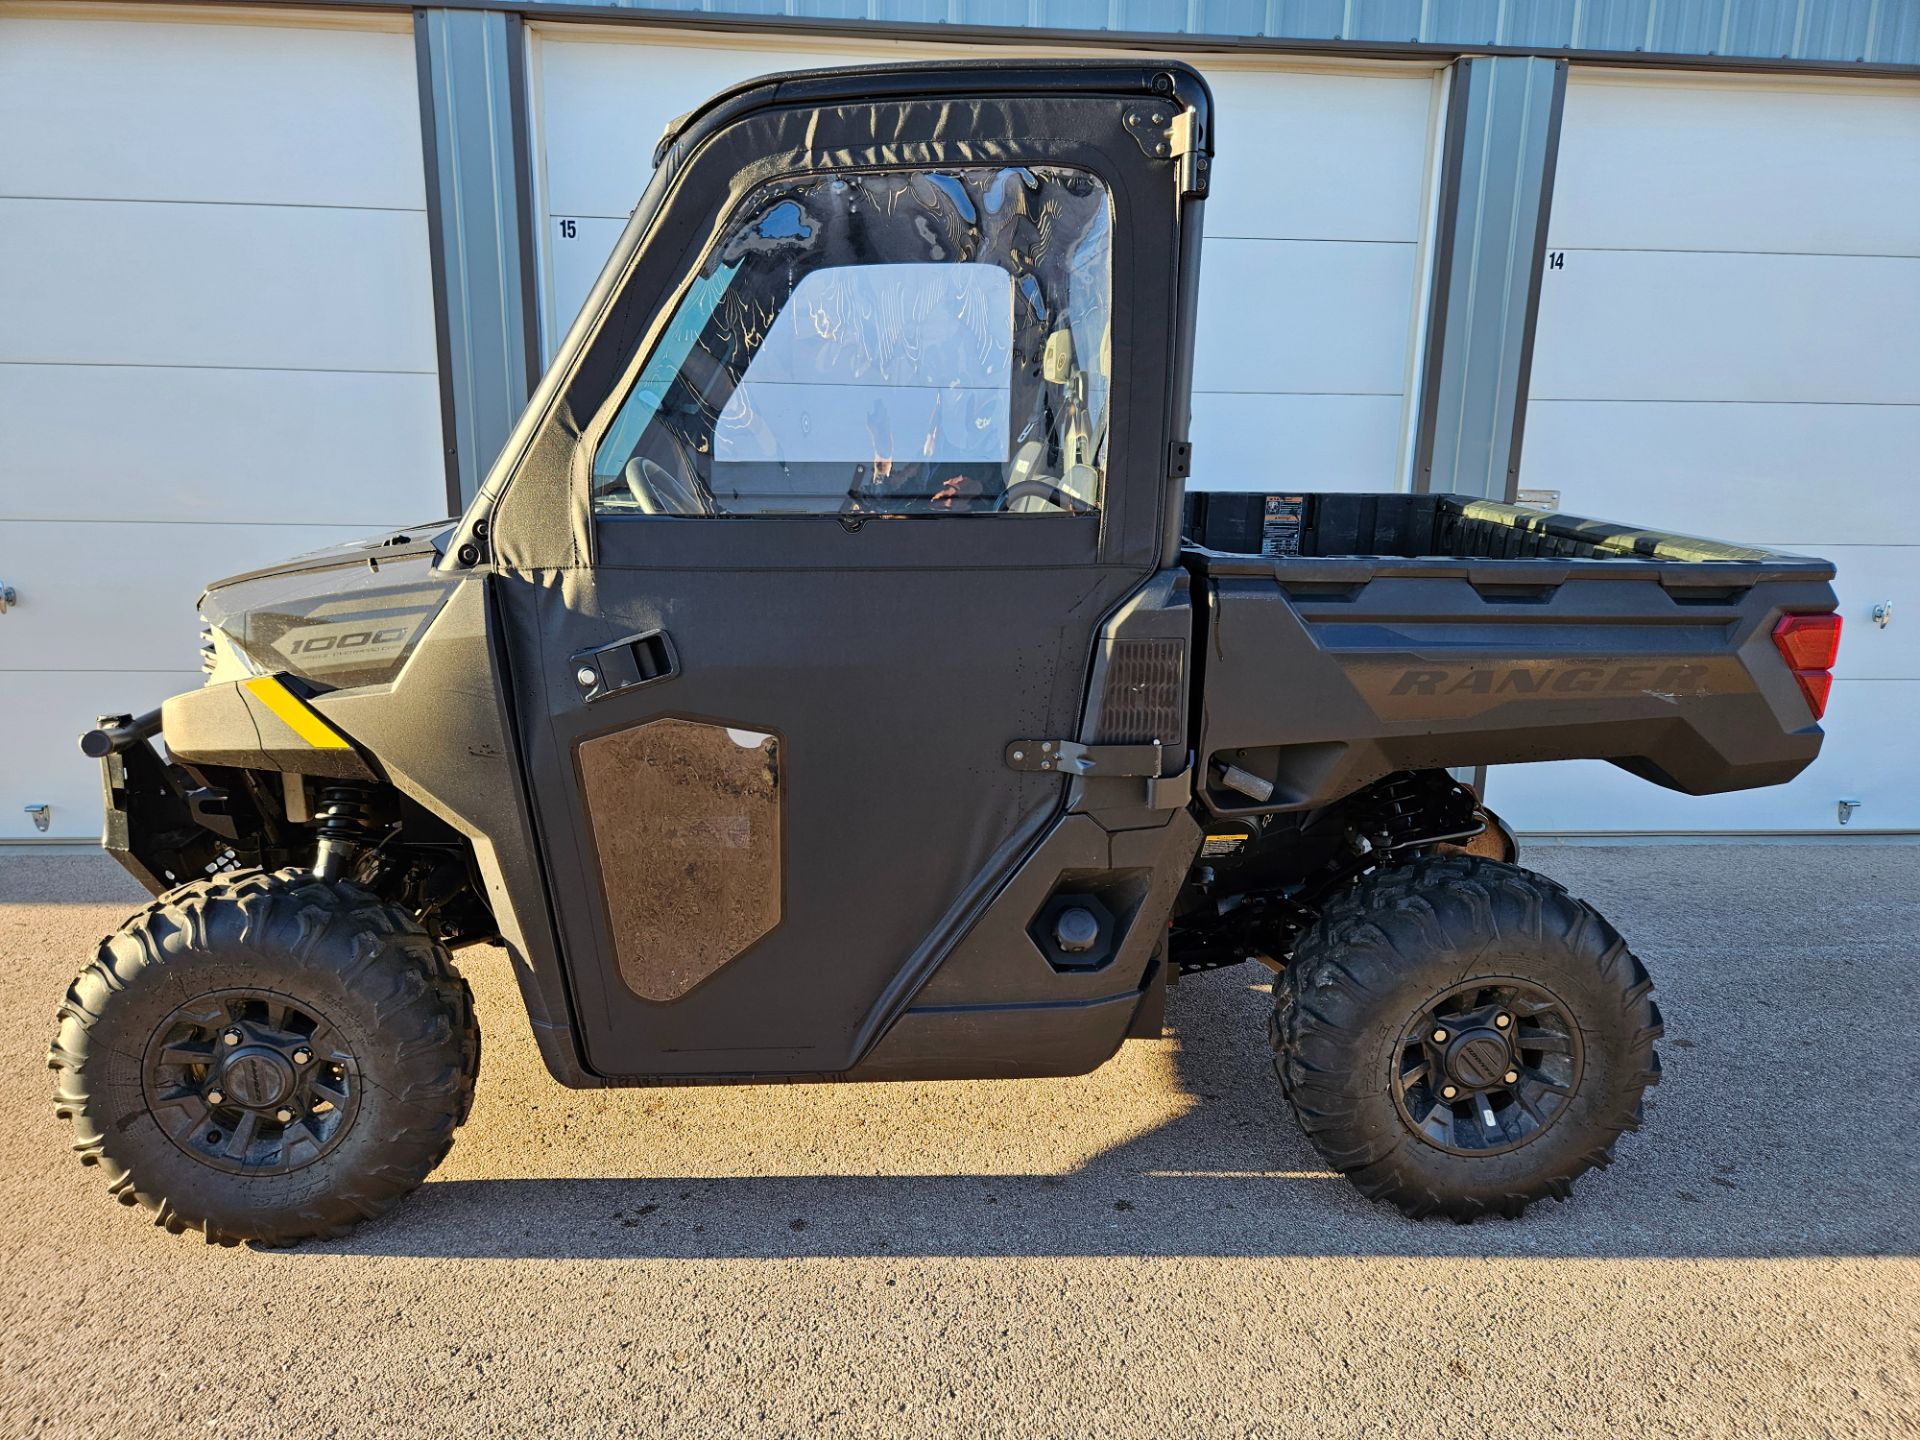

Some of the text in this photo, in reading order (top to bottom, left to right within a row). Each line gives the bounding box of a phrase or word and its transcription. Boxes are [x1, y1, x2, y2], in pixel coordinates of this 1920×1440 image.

[559, 219, 577, 239] 15
[1549, 251, 1564, 270] 14
[290, 627, 408, 655] 1000
[1390, 665, 1709, 695] RANGER
